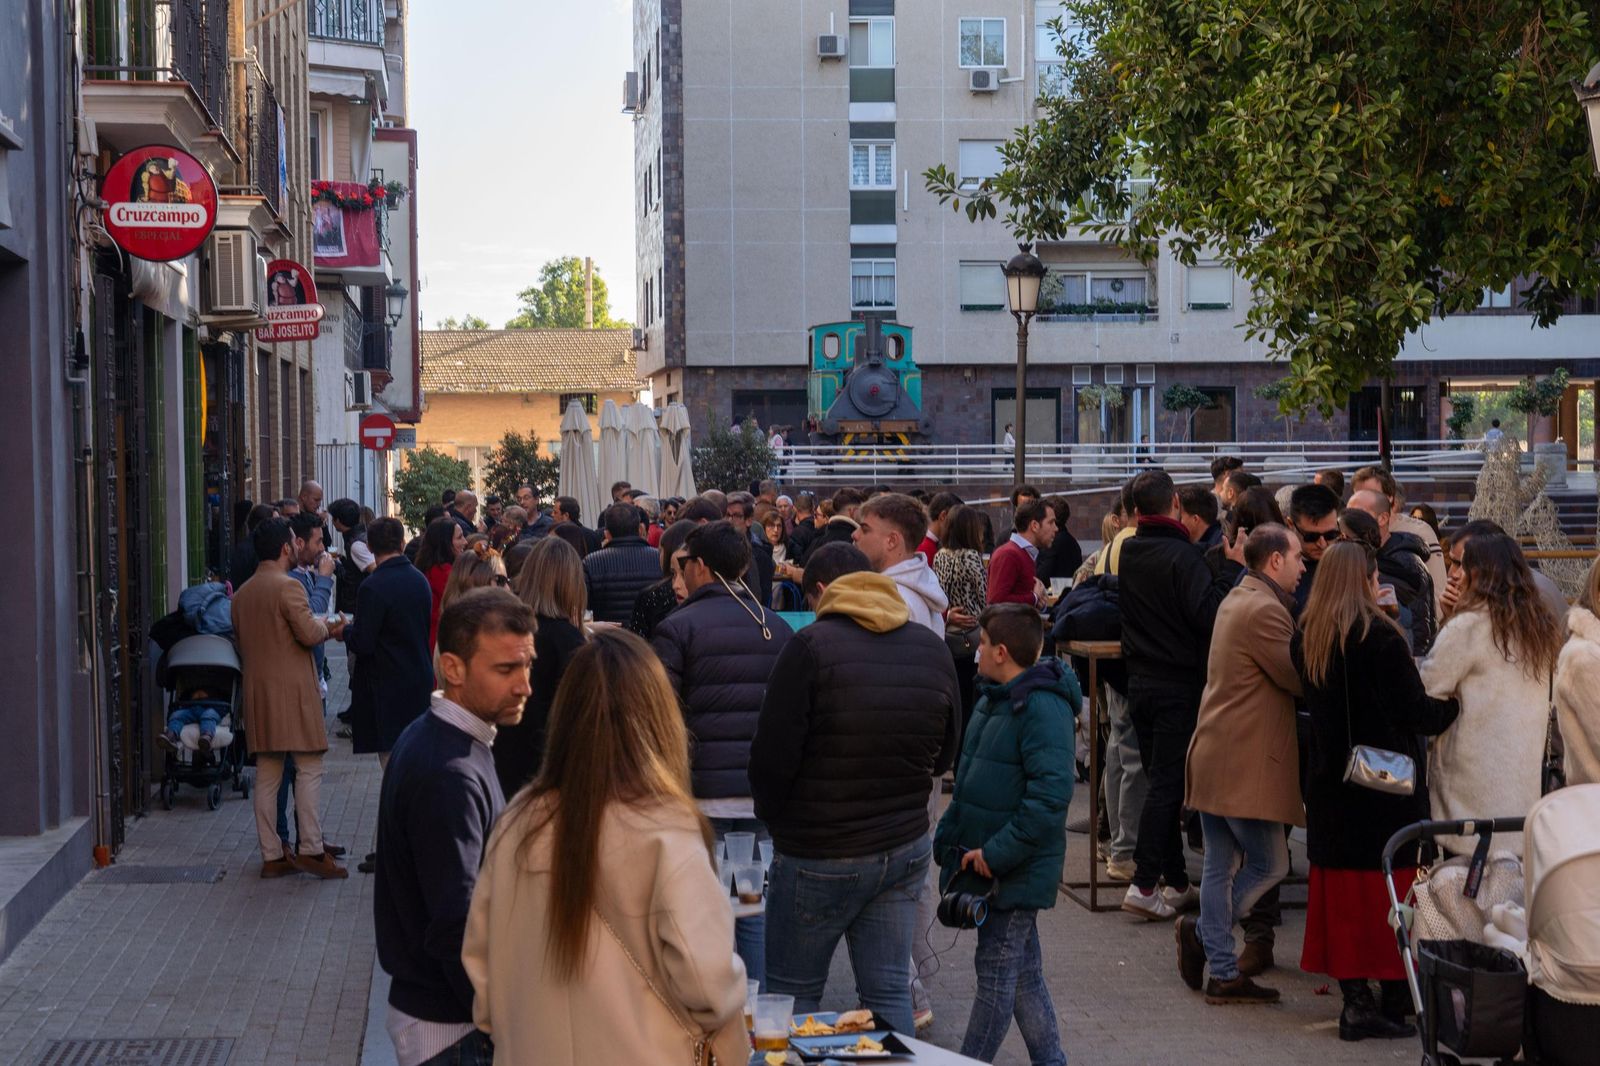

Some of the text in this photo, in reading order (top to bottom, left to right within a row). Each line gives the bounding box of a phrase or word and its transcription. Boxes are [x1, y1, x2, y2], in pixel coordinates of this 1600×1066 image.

[117, 207, 200, 225] Cruzcampo
[134, 230, 182, 240] ESPECIAL
[267, 309, 318, 320] uzcampo
[258, 323, 314, 338] BAR JOSELITO
